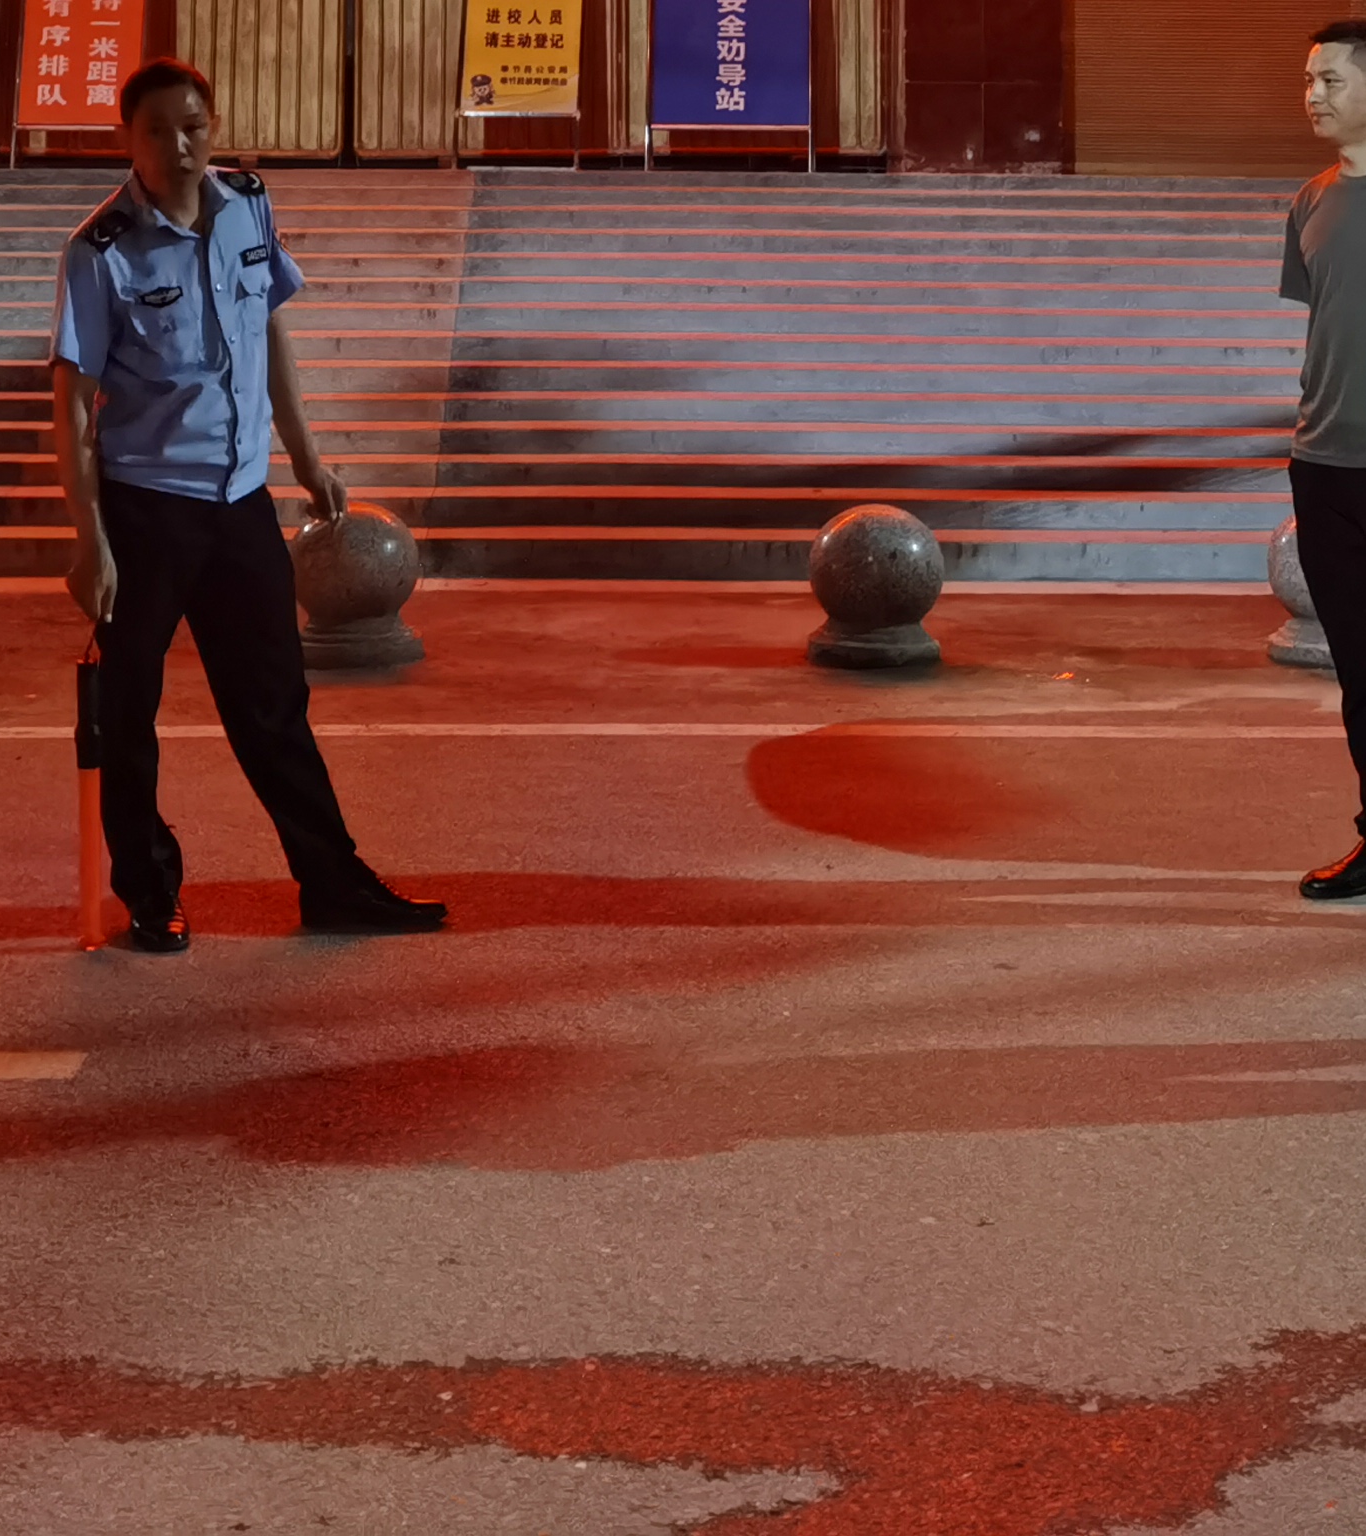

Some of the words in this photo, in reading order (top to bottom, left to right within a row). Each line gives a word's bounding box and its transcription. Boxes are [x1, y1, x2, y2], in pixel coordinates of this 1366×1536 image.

[485, 8, 563, 25] 进校人员
[484, 31, 565, 49] 请主动登记
